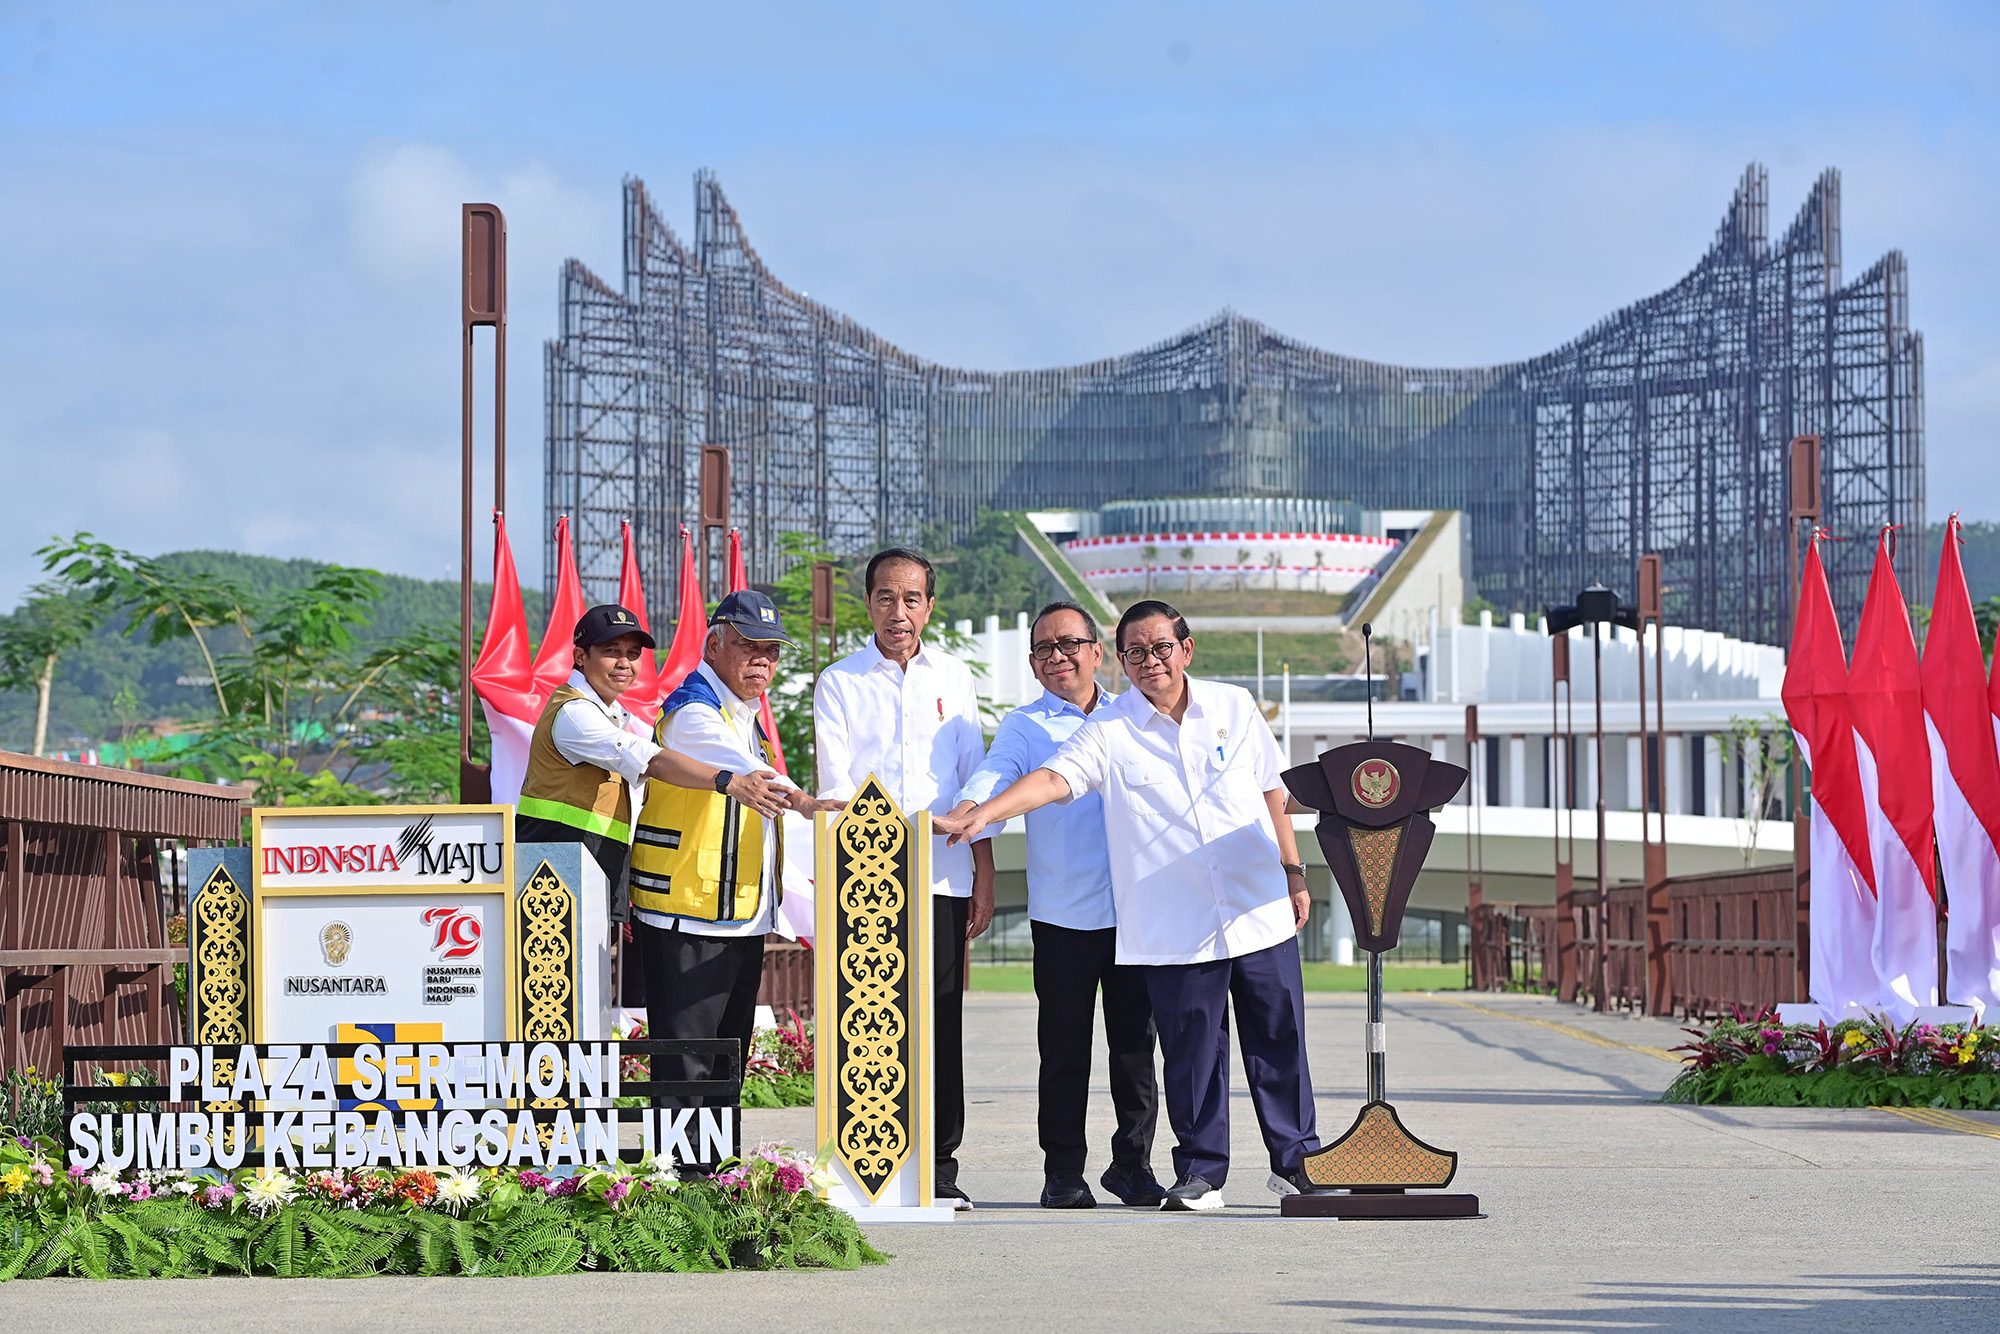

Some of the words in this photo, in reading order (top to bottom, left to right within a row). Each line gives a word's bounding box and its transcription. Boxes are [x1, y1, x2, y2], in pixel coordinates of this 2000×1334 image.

[418, 843, 503, 883] MAJU
[425, 908, 481, 958] 79
[288, 978, 386, 993] NUSANTARA
[427, 967, 481, 975] NUSANTARA
[427, 986, 475, 994] INDONESIA
[169, 1045, 337, 1103] PLAZA
[351, 1042, 620, 1101] SEREMONI
[68, 1111, 246, 1170] SUMBU
[263, 1108, 619, 1169] KEBANGSAAN
[642, 1107, 733, 1165] IKN
